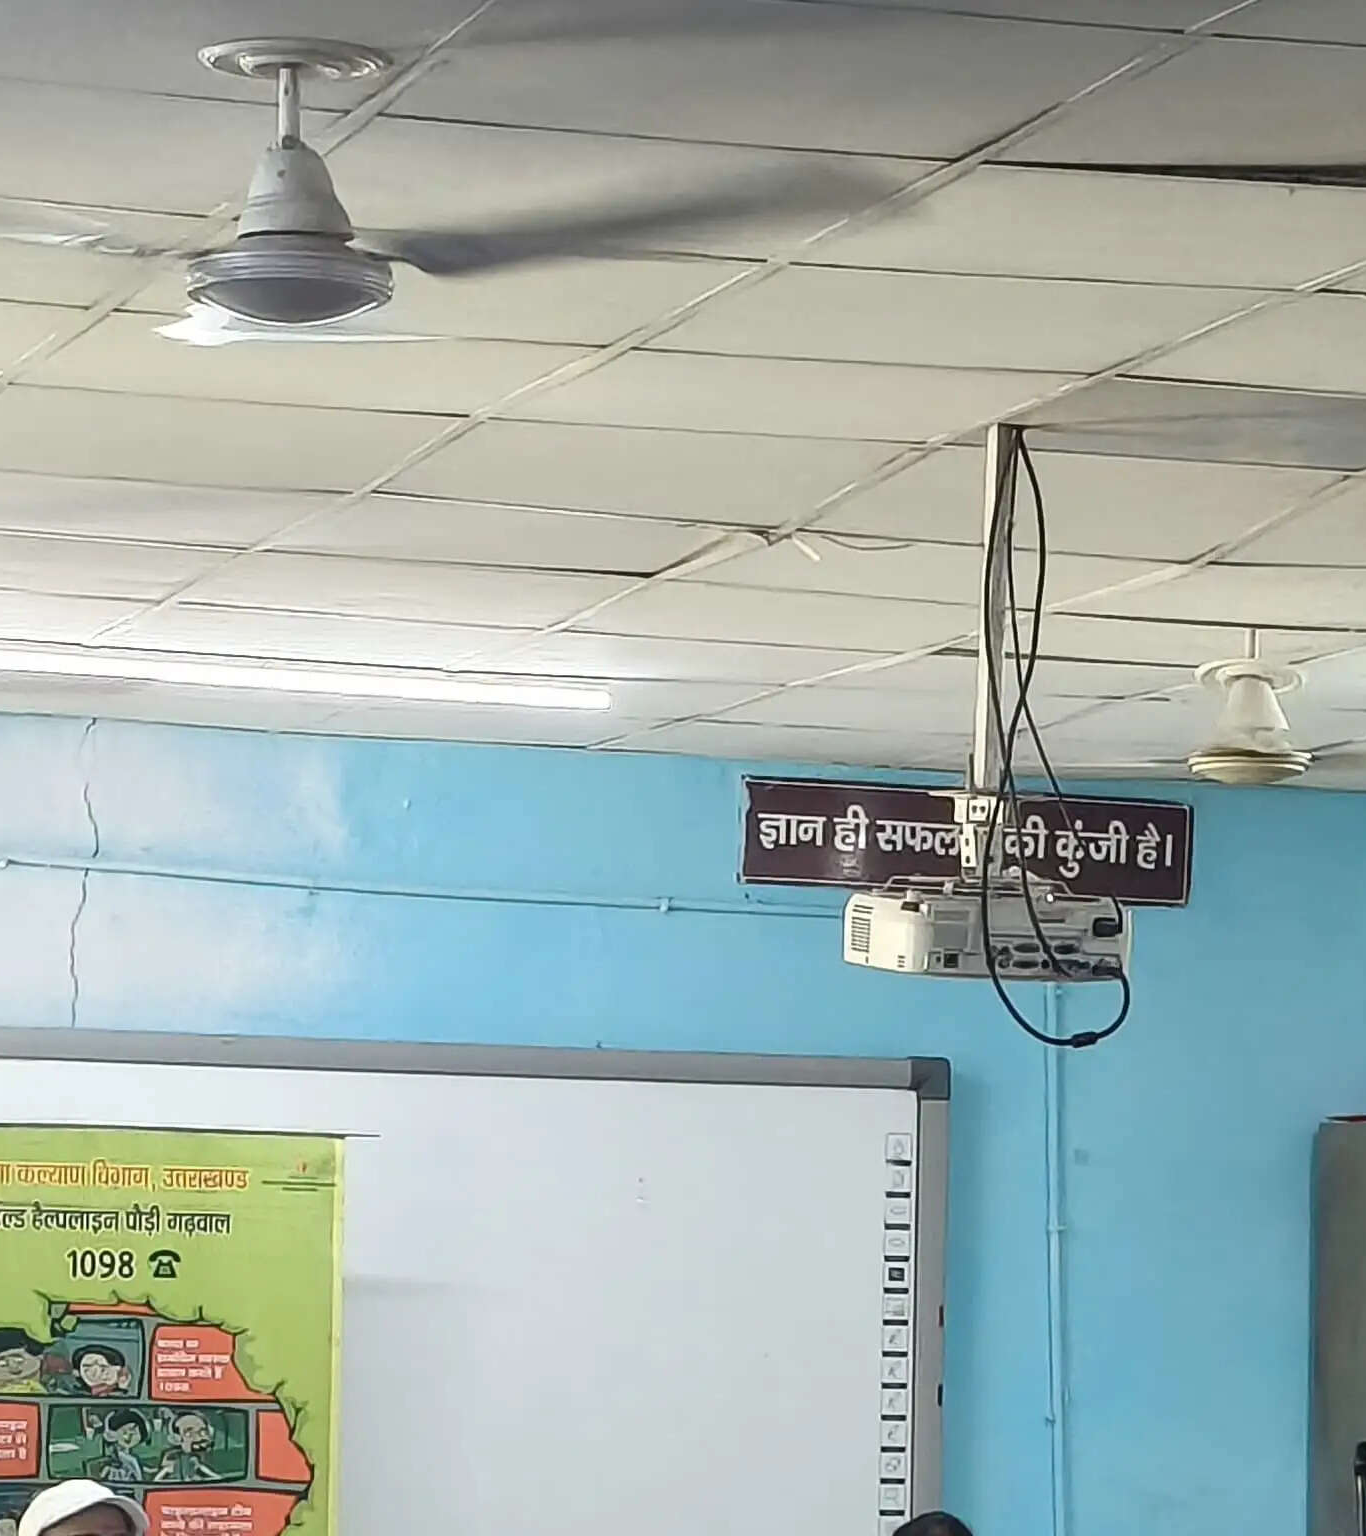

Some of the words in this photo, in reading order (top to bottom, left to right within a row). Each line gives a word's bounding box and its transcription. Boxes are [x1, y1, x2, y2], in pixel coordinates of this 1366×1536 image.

[756, 812, 827, 848] ज्ञान
[833, 805, 869, 852] ही
[1003, 815, 1049, 860] की
[1055, 818, 1129, 877] कुंजी
[1135, 822, 1173, 870] है।
[16, 1162, 86, 1188] कल्याण
[166, 1210, 232, 1240] गढ़वाल
[66, 1249, 135, 1280] 1098
